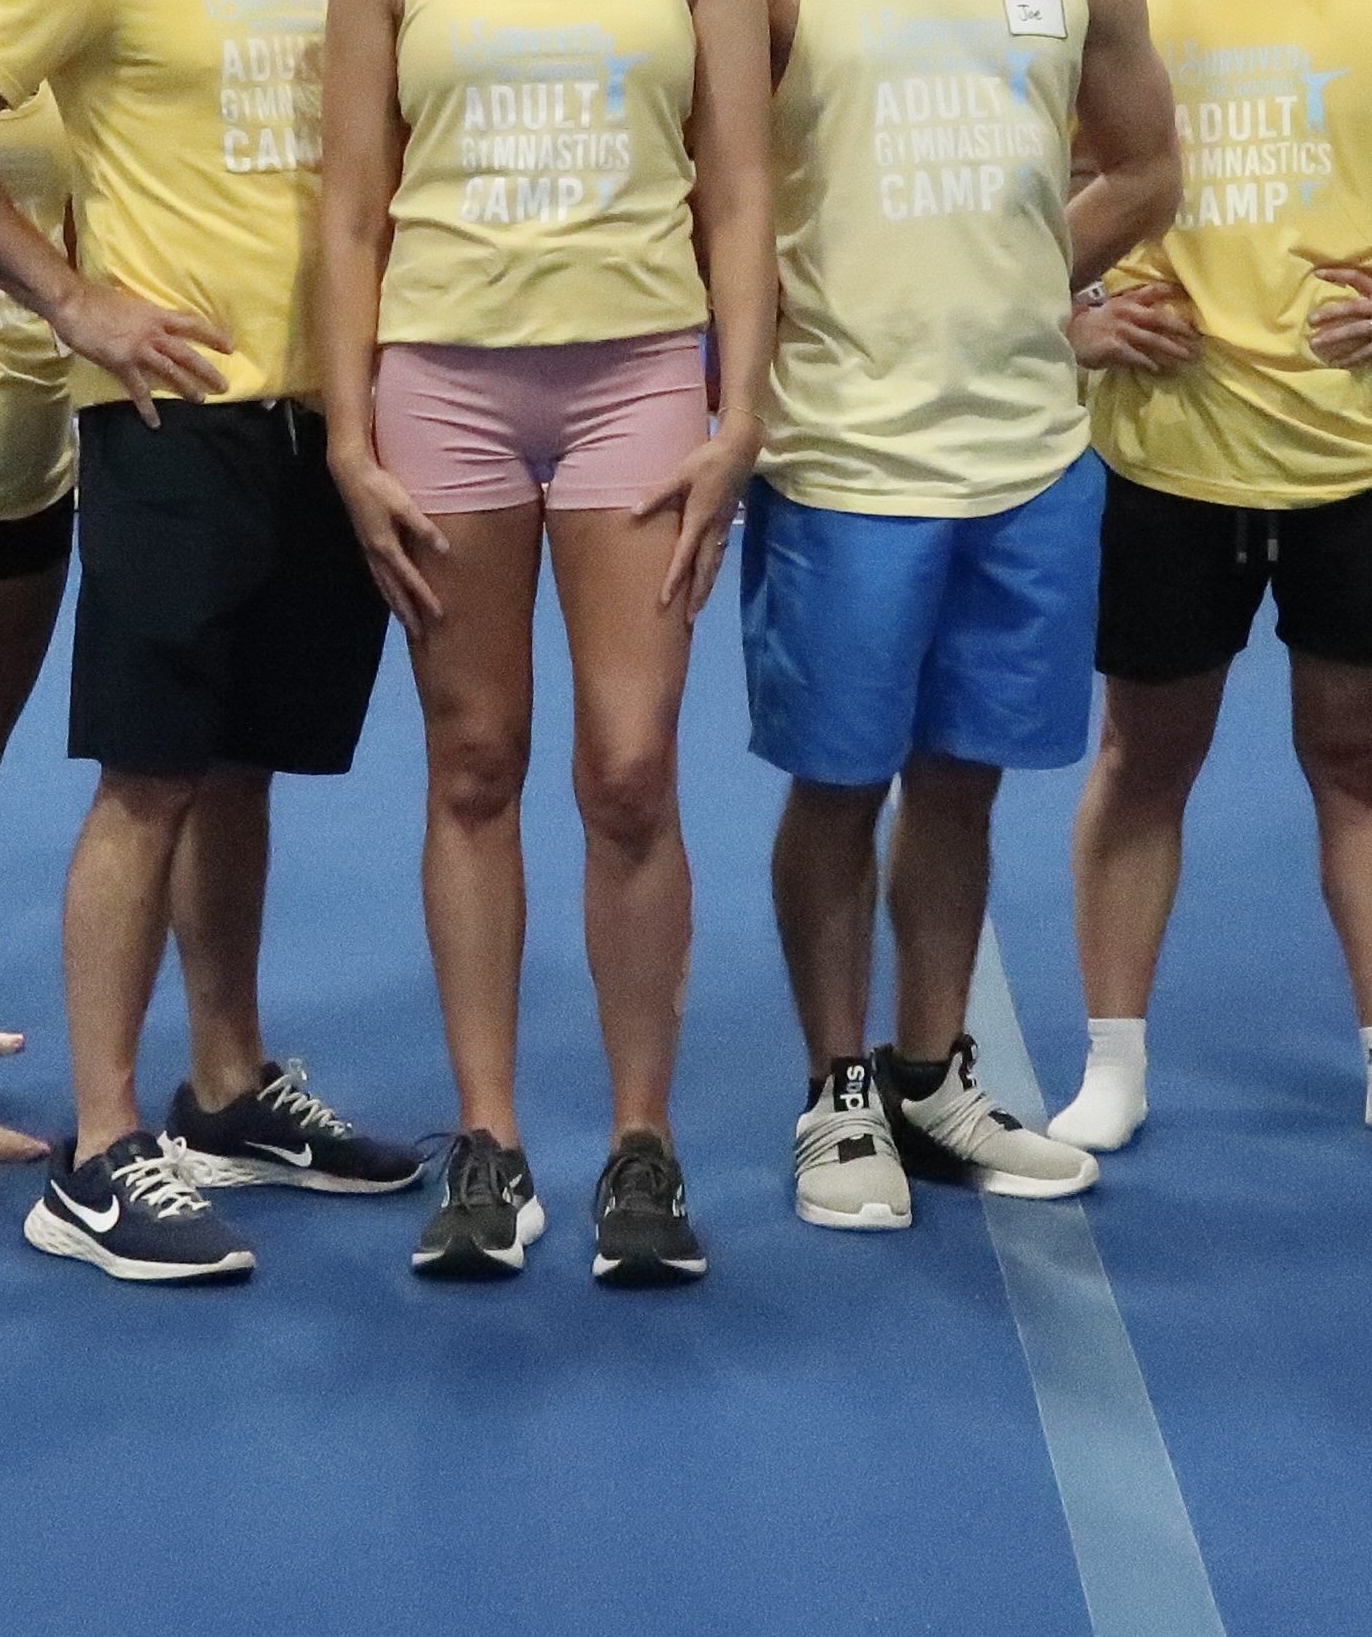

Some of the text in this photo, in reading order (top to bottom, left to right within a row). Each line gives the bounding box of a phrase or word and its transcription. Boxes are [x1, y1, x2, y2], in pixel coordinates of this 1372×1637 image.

[1016, 3, 1043, 22] Joe
[463, 82, 600, 131] ADULT
[876, 76, 1004, 127] ADULT
[461, 133, 630, 171] GYMNASTICS
[875, 123, 1044, 166] GYMNASTICS
[1183, 142, 1333, 181] YMNASTICS
[461, 176, 586, 224] CAMP
[880, 164, 1006, 223] CAMP
[1175, 181, 1290, 230] AMP
